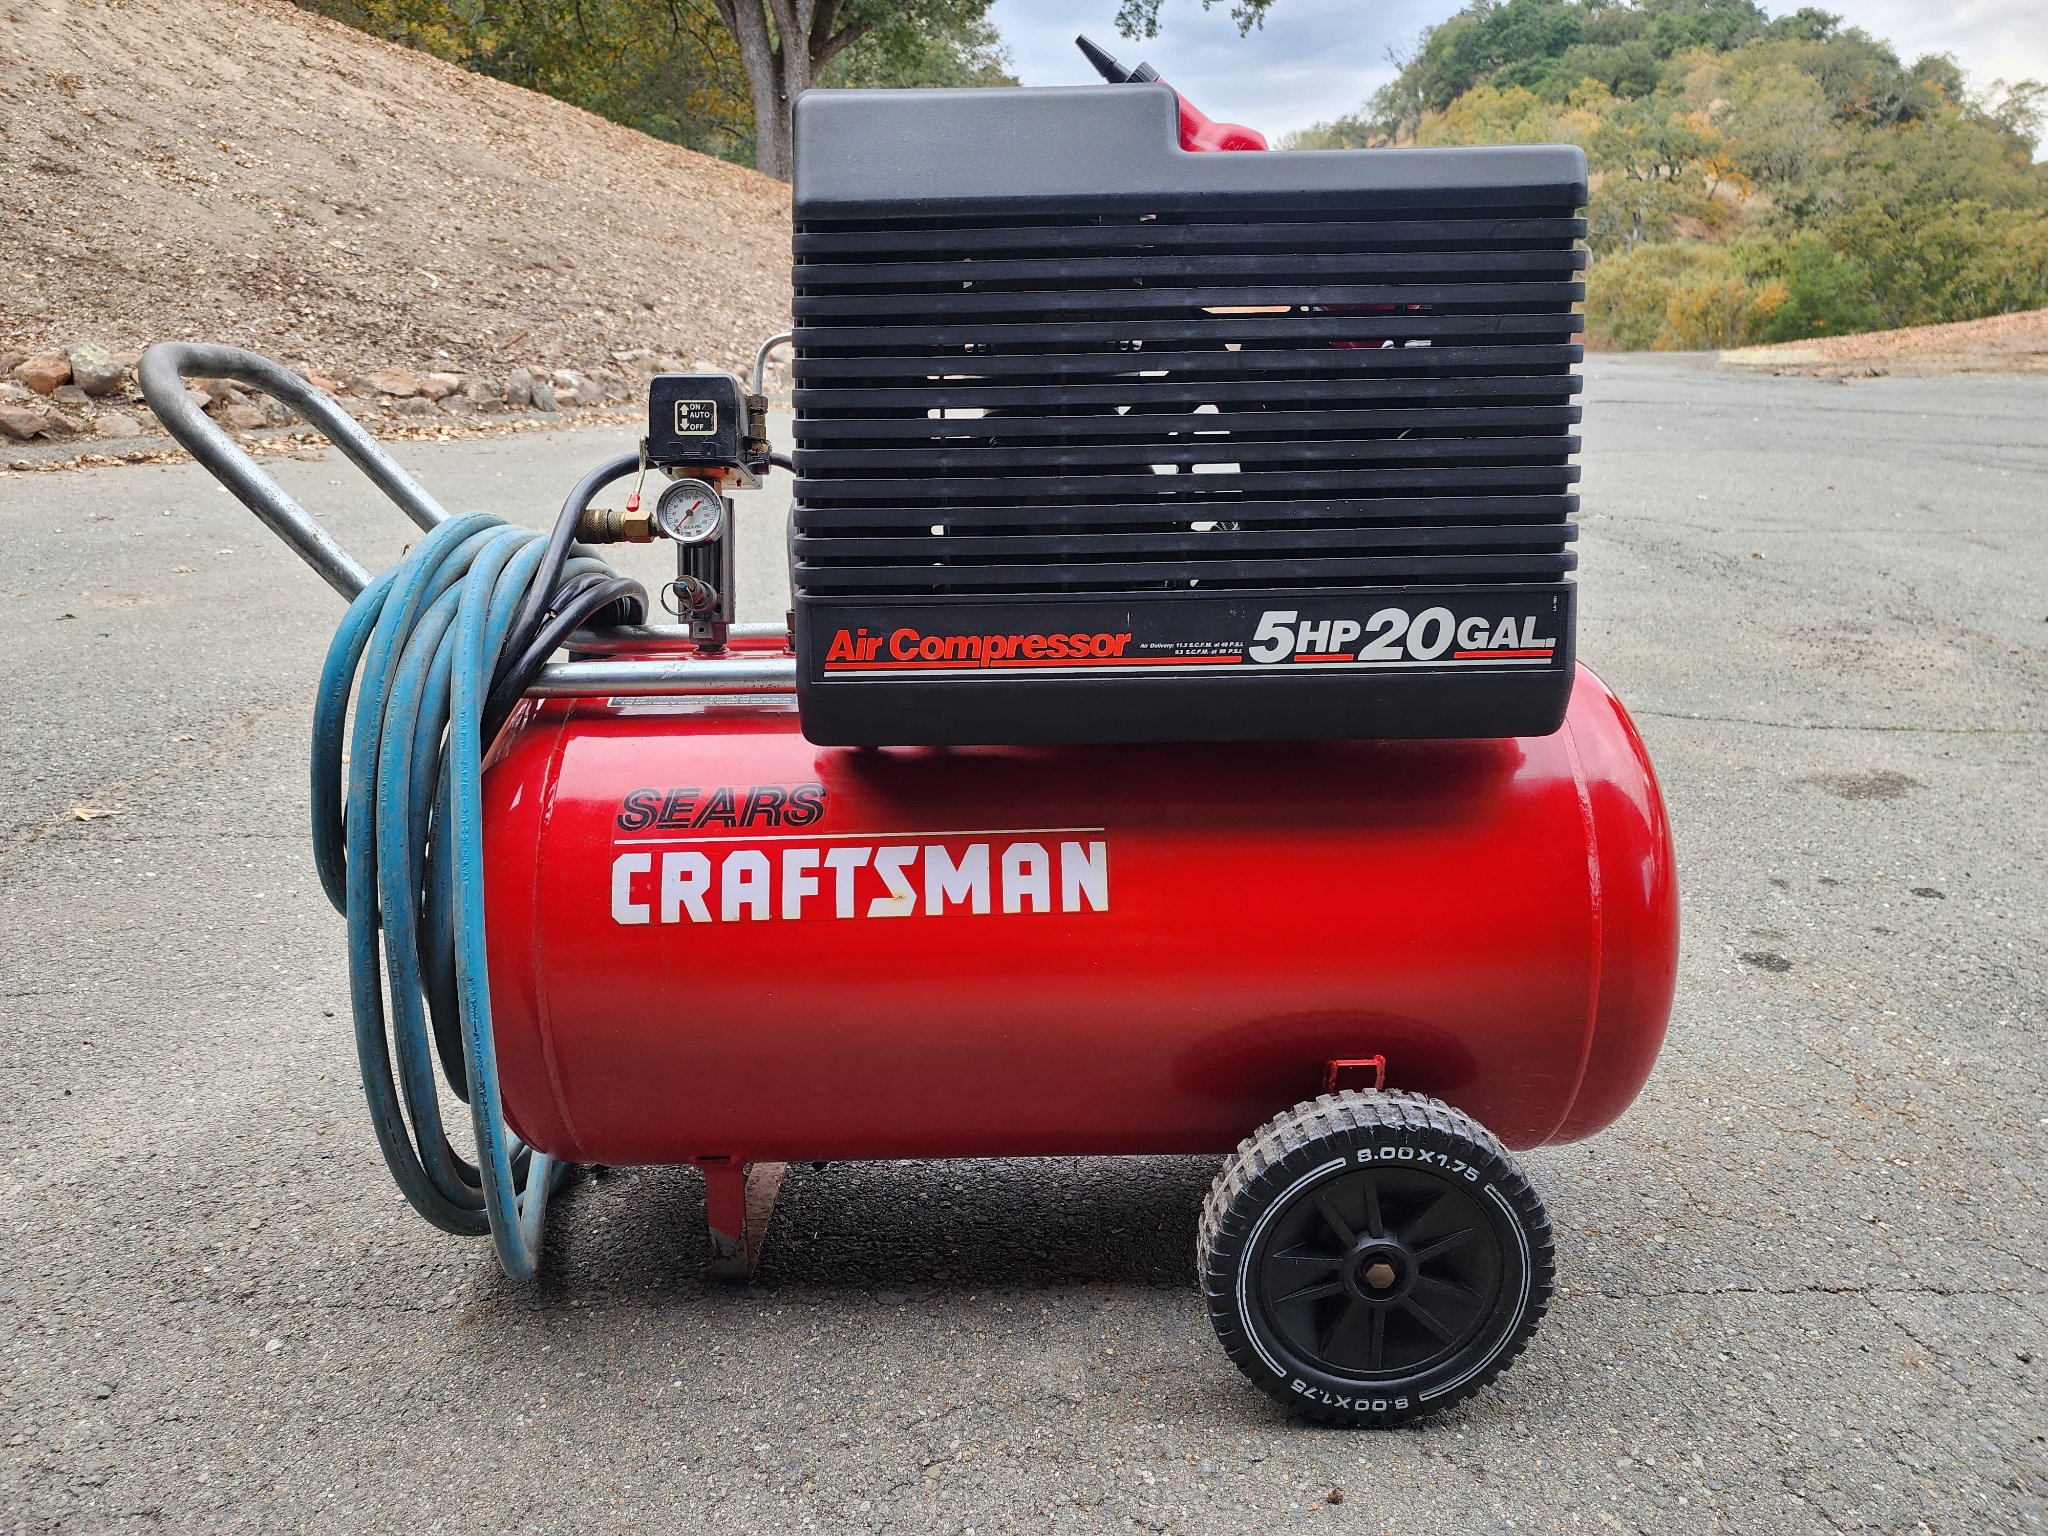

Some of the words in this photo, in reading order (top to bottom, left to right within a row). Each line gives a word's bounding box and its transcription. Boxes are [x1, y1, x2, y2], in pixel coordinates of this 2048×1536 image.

[826, 629, 883, 661] Air
[889, 628, 1132, 667] Compressor
[617, 783, 826, 831] SEARS
[611, 841, 1109, 925] CRAFTSMAN
